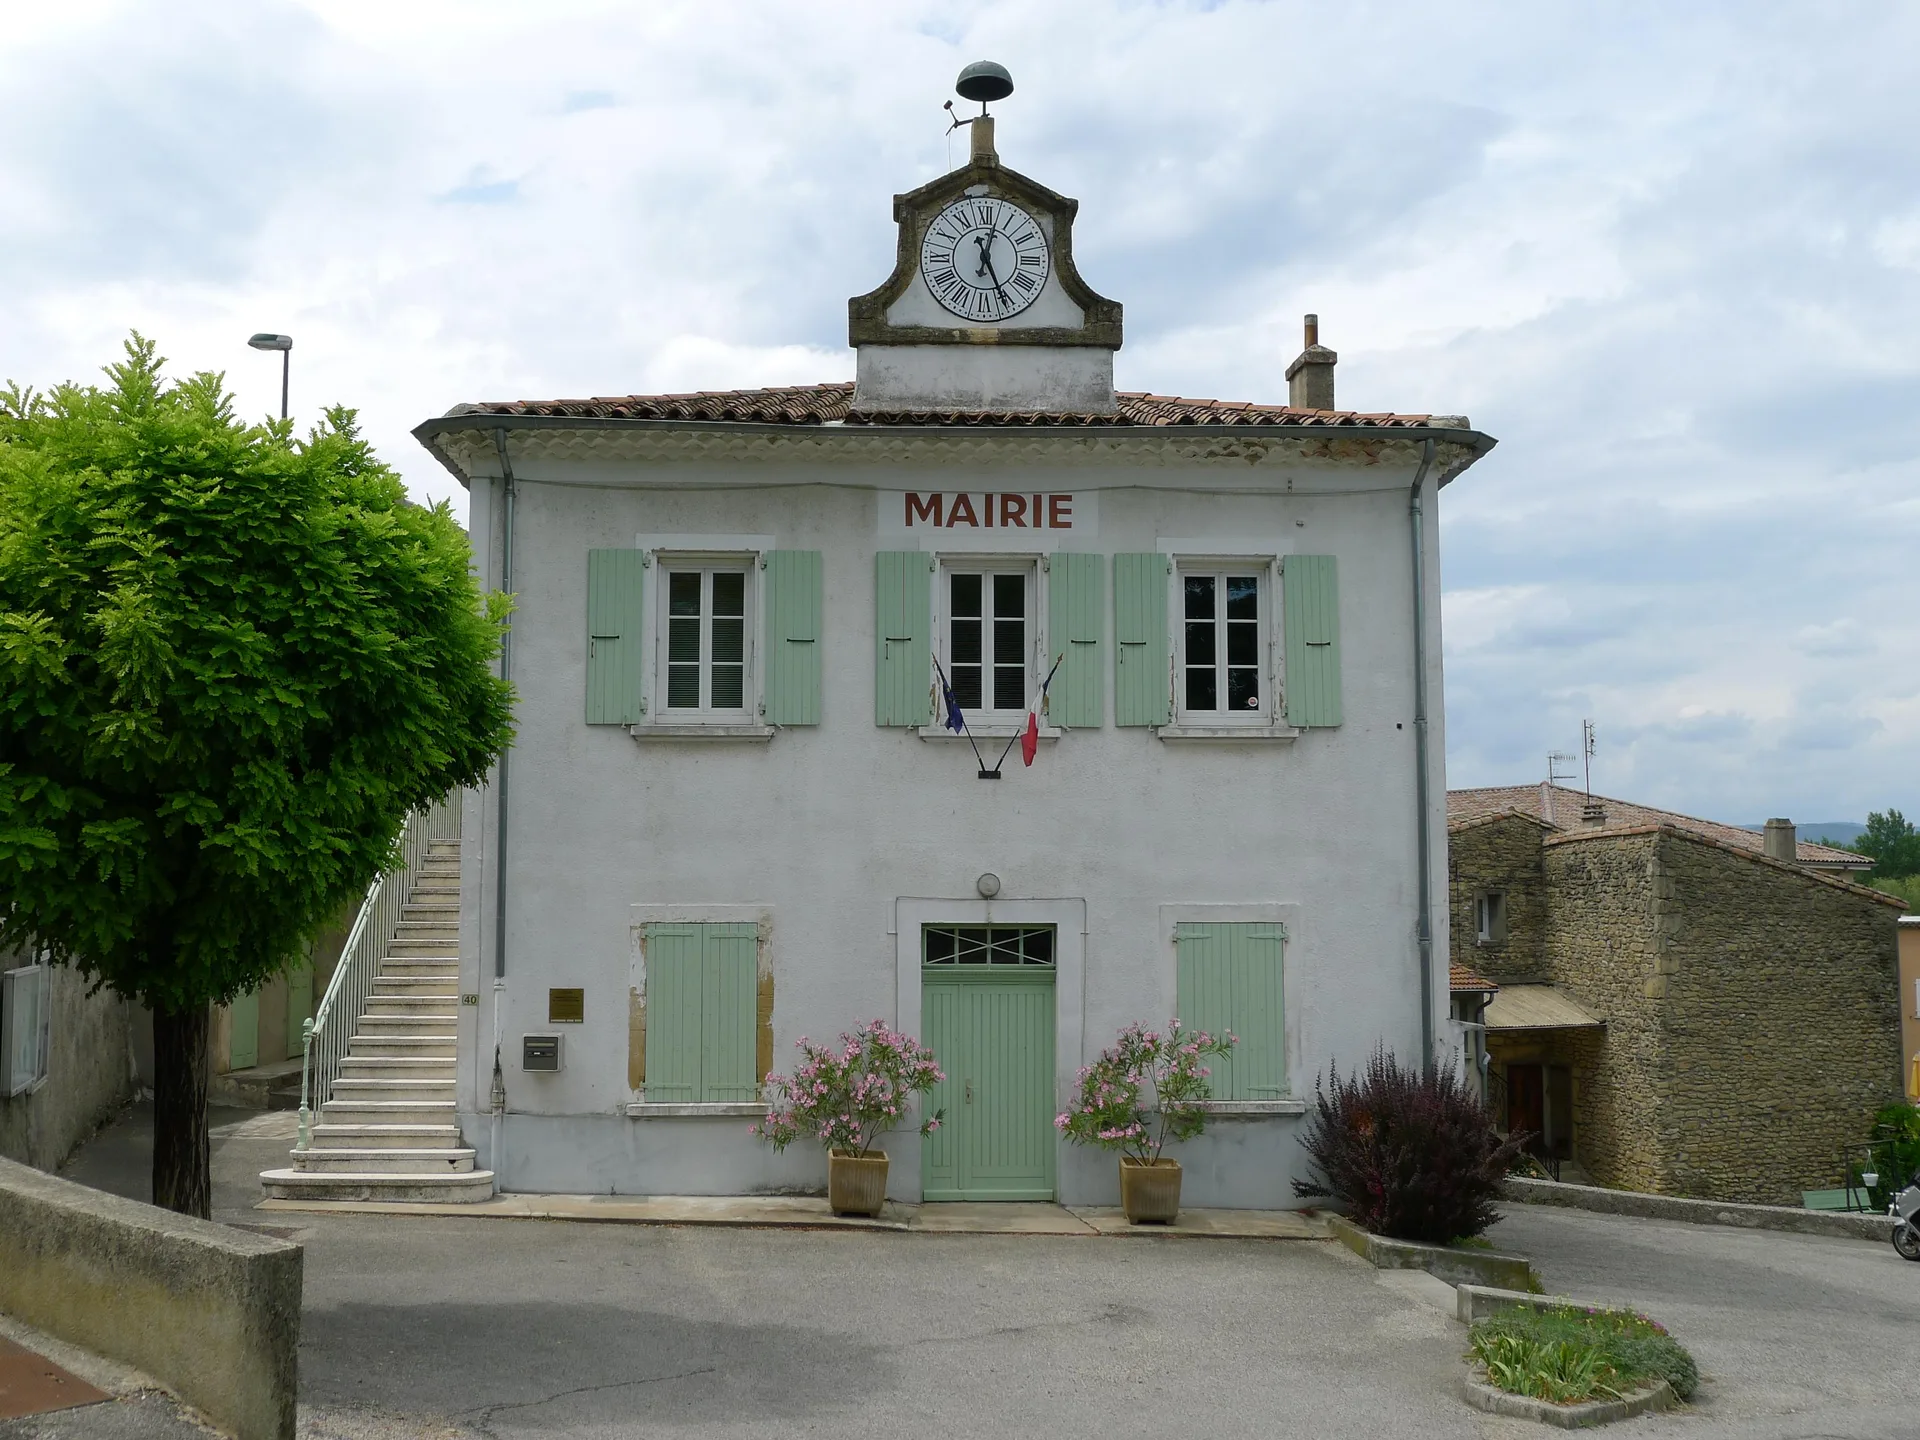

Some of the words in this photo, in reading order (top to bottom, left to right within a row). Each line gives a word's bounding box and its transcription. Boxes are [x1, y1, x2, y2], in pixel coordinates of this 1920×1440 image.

[952, 210, 973, 231] XI
[977, 206, 993, 225] XII
[1002, 213, 1015, 231] I
[936, 227, 956, 243] X
[1014, 231, 1035, 245] II
[930, 251, 950, 263] IX
[1020, 255, 1040, 266] III
[933, 269, 958, 294] VIII
[1012, 271, 1036, 293] IIII
[950, 284, 971, 308] VII
[977, 292, 992, 313] VI
[905, 492, 1073, 529] MAIRIE
[464, 995, 477, 1004] 40
